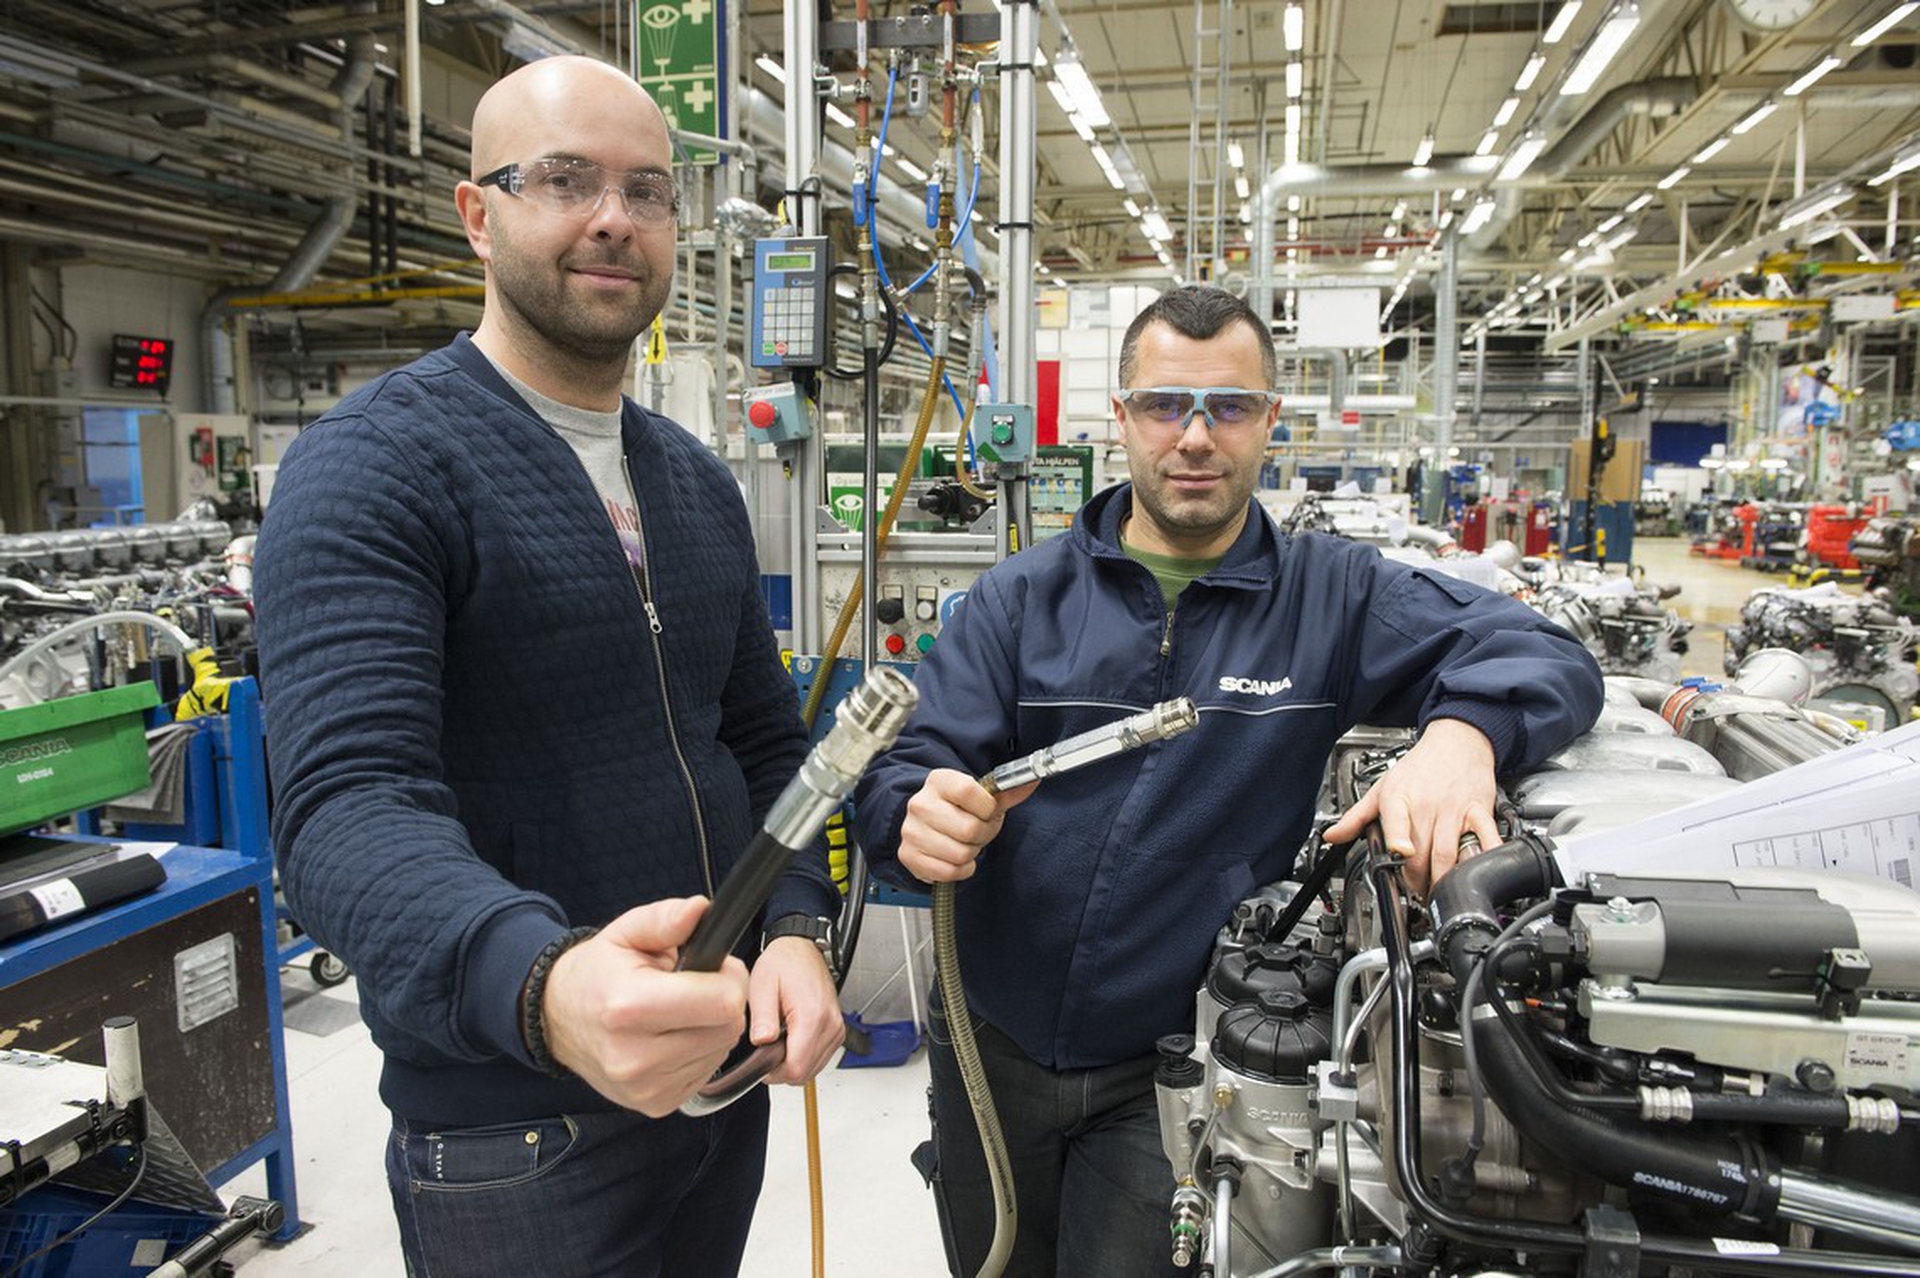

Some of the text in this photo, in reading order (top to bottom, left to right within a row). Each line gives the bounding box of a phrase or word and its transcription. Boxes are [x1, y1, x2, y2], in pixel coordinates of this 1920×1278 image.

[1046, 456, 1079, 466] HJÄLPEN
[1219, 676, 1292, 696] SCANIA
[1850, 1058, 1888, 1068] SCANIA
